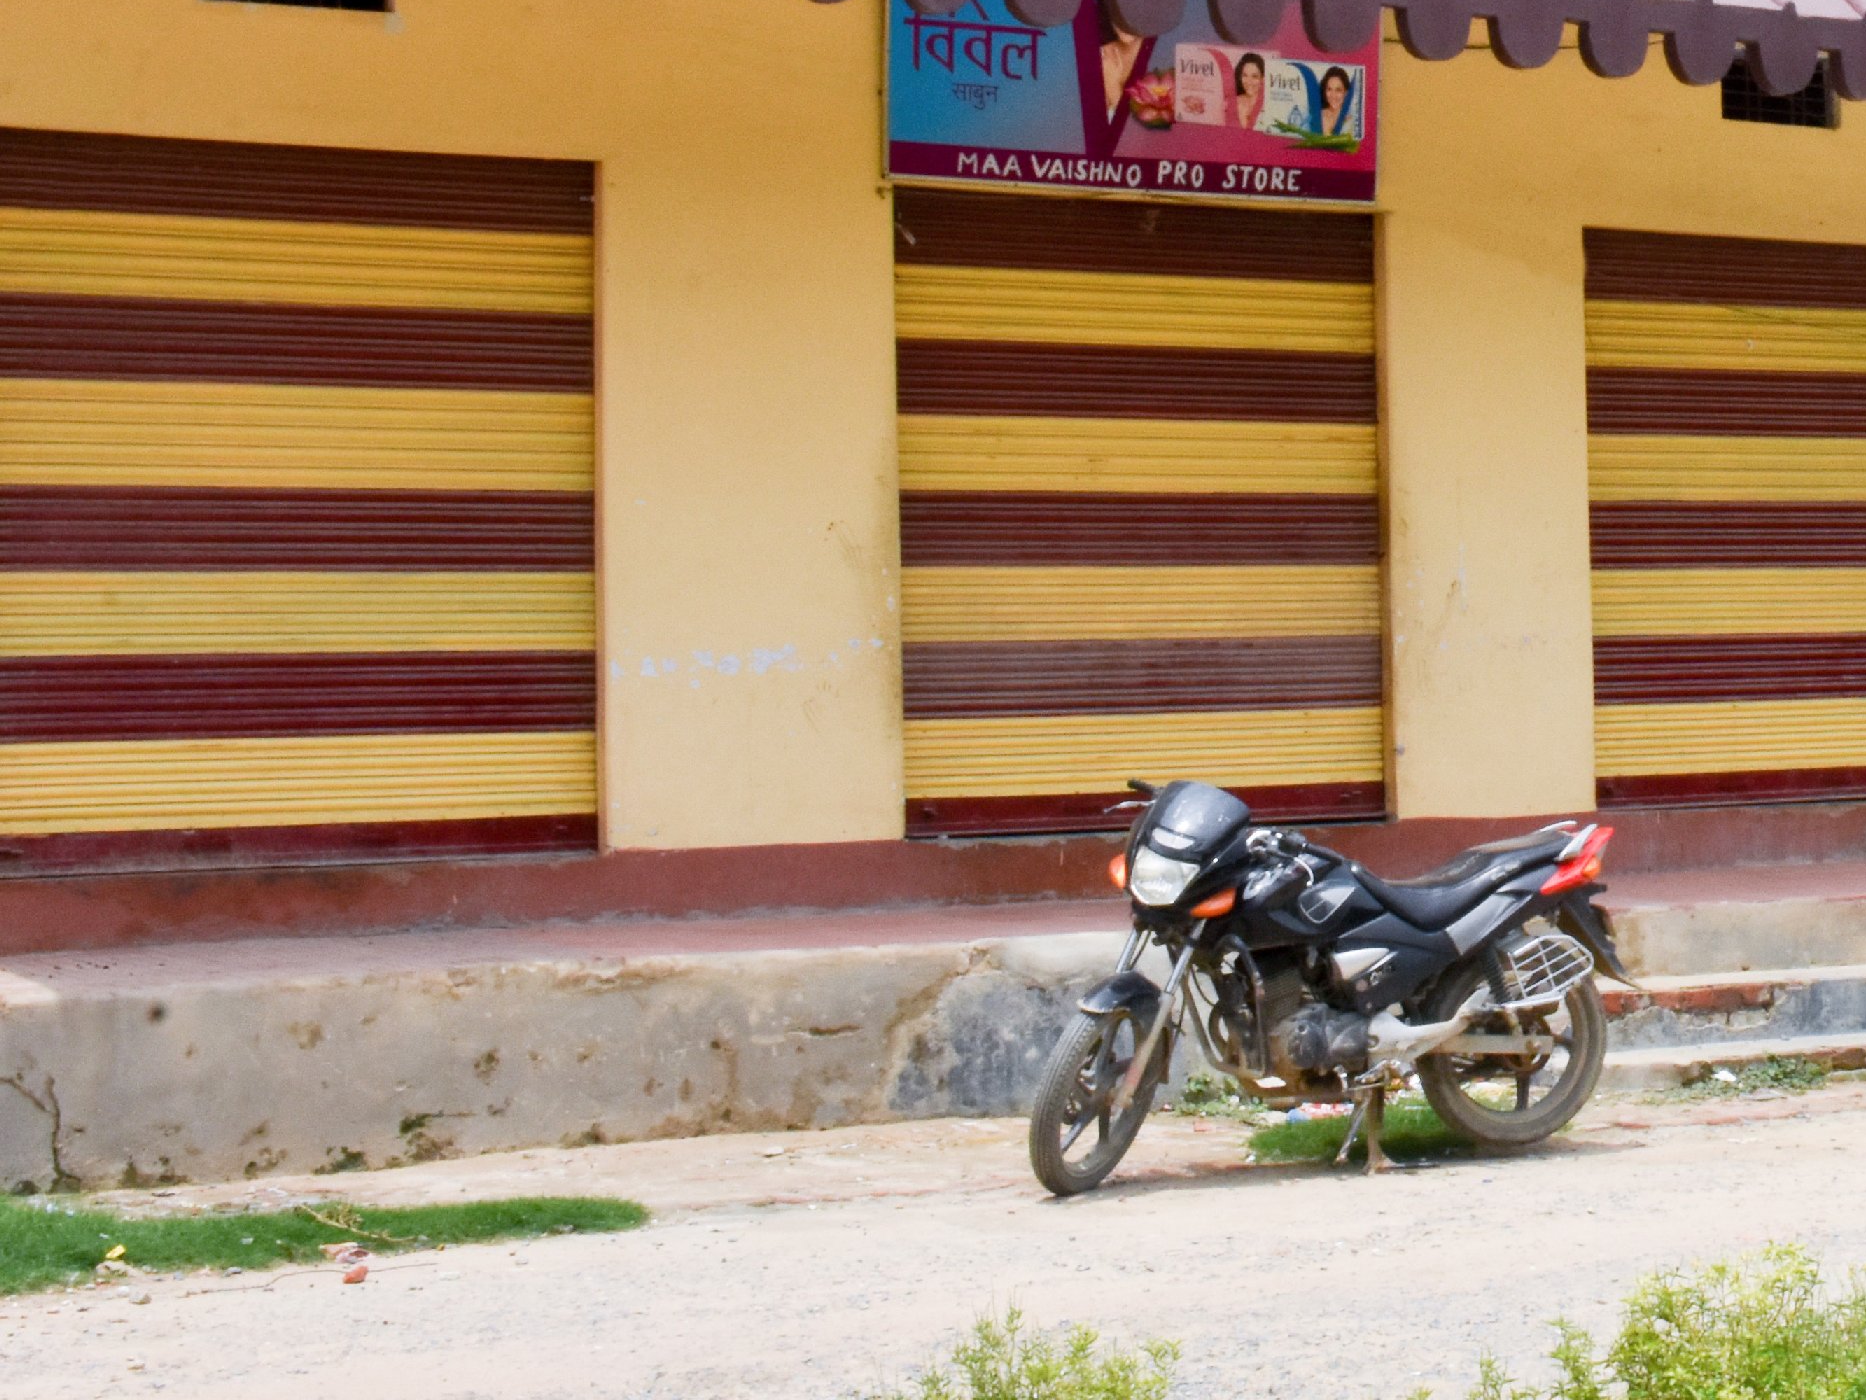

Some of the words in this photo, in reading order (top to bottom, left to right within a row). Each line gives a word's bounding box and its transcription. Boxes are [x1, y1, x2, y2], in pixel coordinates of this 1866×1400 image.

[1180, 59, 1215, 77] Vivel
[1269, 73, 1302, 91] Vivel
[951, 82, 998, 110] साबुन
[957, 152, 1022, 178] MAA
[1032, 154, 1142, 188] VAISHNO
[1157, 160, 1204, 188] PRO
[1222, 165, 1302, 192] STORE
